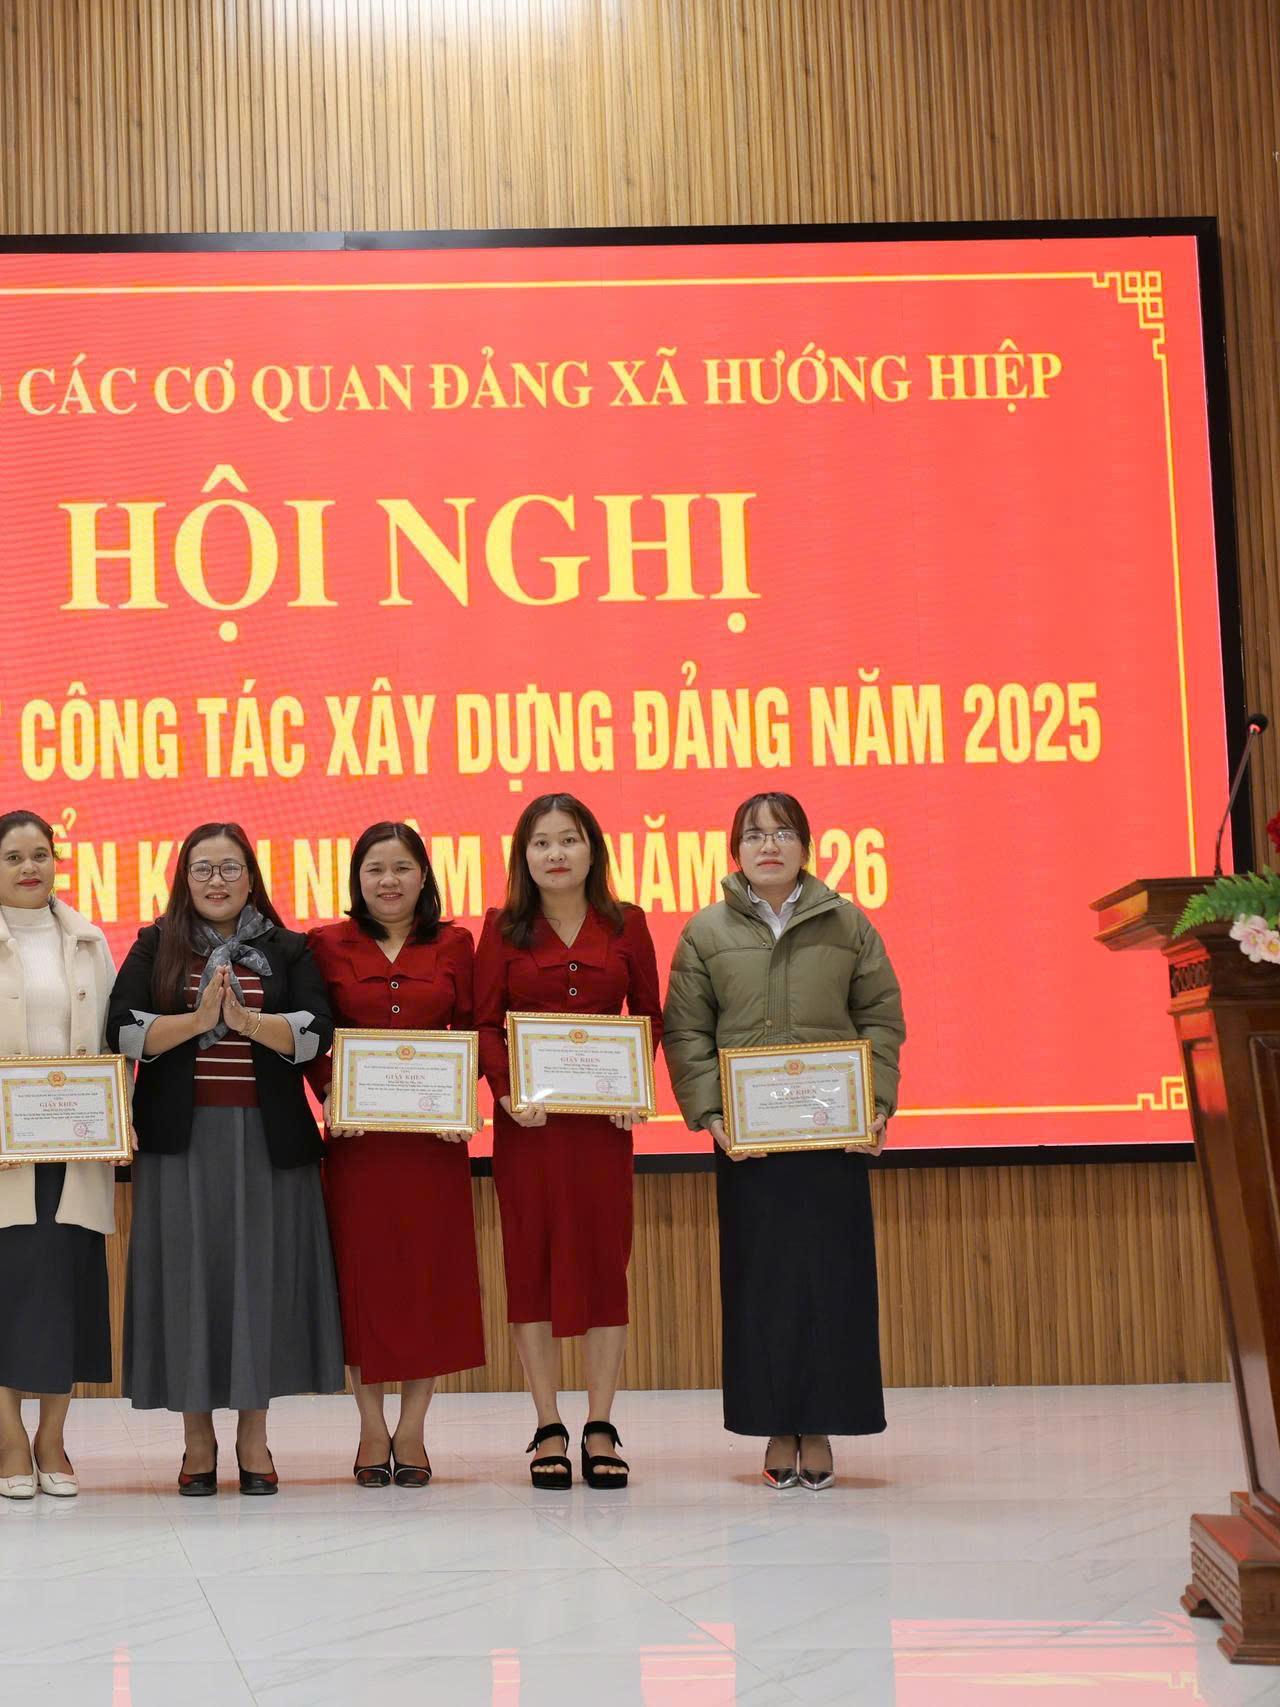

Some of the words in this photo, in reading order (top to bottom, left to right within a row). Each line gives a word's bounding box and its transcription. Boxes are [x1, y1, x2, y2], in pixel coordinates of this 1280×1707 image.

[18, 353, 137, 416] CÁC
[153, 358, 236, 414] CƠ
[251, 363, 414, 423] QUAN
[428, 345, 593, 411] ĐẢNG
[607, 347, 687, 408] XÃ
[703, 342, 912, 406] HƯỚNG
[927, 338, 1062, 413] HIỆP
[58, 463, 339, 643] HỘI
[376, 492, 762, 634] NGHỊ
[20, 681, 179, 782] CÔNG
[196, 678, 306, 778] TÁC
[324, 677, 437, 777] XÂY
[455, 683, 615, 793] DỰNG
[631, 660, 792, 771] ĐẢNG
[809, 667, 945, 767] NĂM
[963, 682, 1102, 764] 2025
[603, 814, 729, 913] NĂM
[807, 827, 888, 910] 26
